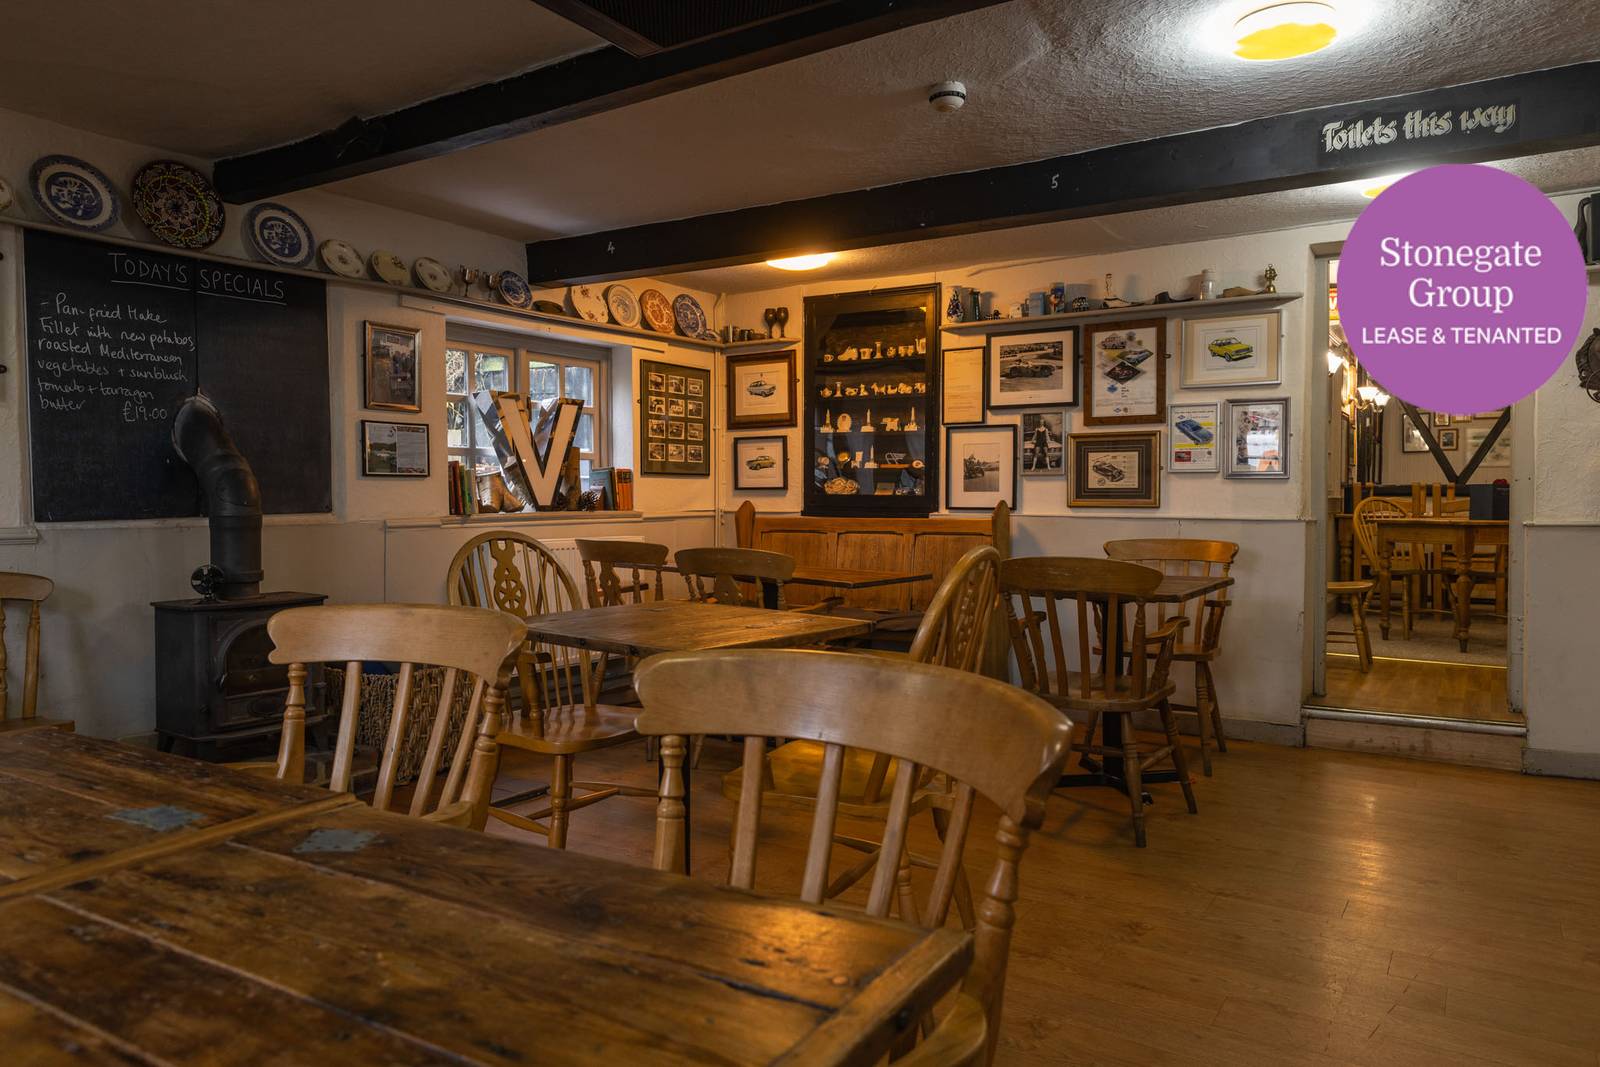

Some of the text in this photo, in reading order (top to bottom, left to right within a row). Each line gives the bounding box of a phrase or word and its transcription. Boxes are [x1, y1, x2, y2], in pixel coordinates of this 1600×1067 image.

[1321, 103, 1517, 154] Toilets this way
[107, 252, 285, 299] TODAY'S SPECIALS
[127, 304, 168, 325] Hake
[39, 316, 80, 337] Fillet
[87, 324, 113, 339] with
[120, 330, 146, 342] new
[37, 337, 92, 356] roasted
[37, 357, 110, 378] vegetables
[37, 377, 85, 393] tomato
[99, 382, 155, 405] tarragon
[39, 394, 87, 412] butter
[122, 400, 168, 422] £19.00
